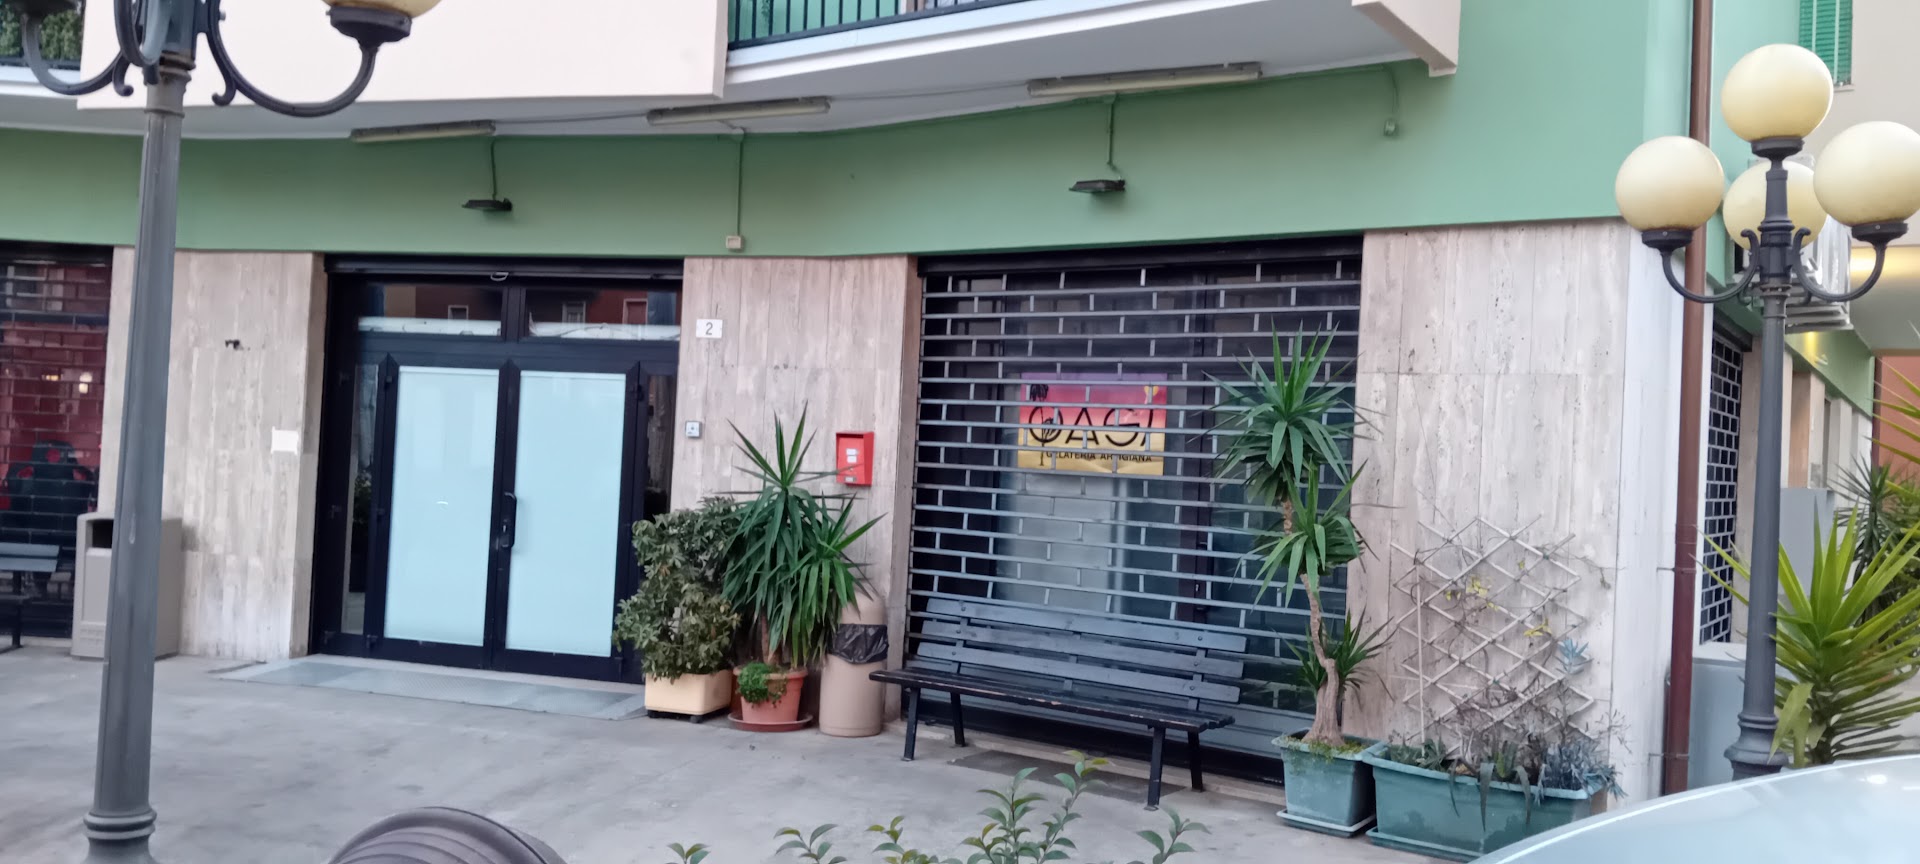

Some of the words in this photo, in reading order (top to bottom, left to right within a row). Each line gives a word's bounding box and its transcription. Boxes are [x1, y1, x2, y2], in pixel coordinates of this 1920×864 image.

[705, 321, 713, 336] 2
[1028, 405, 1154, 447] OASI
[1100, 452, 1153, 462] ARIGIANA
